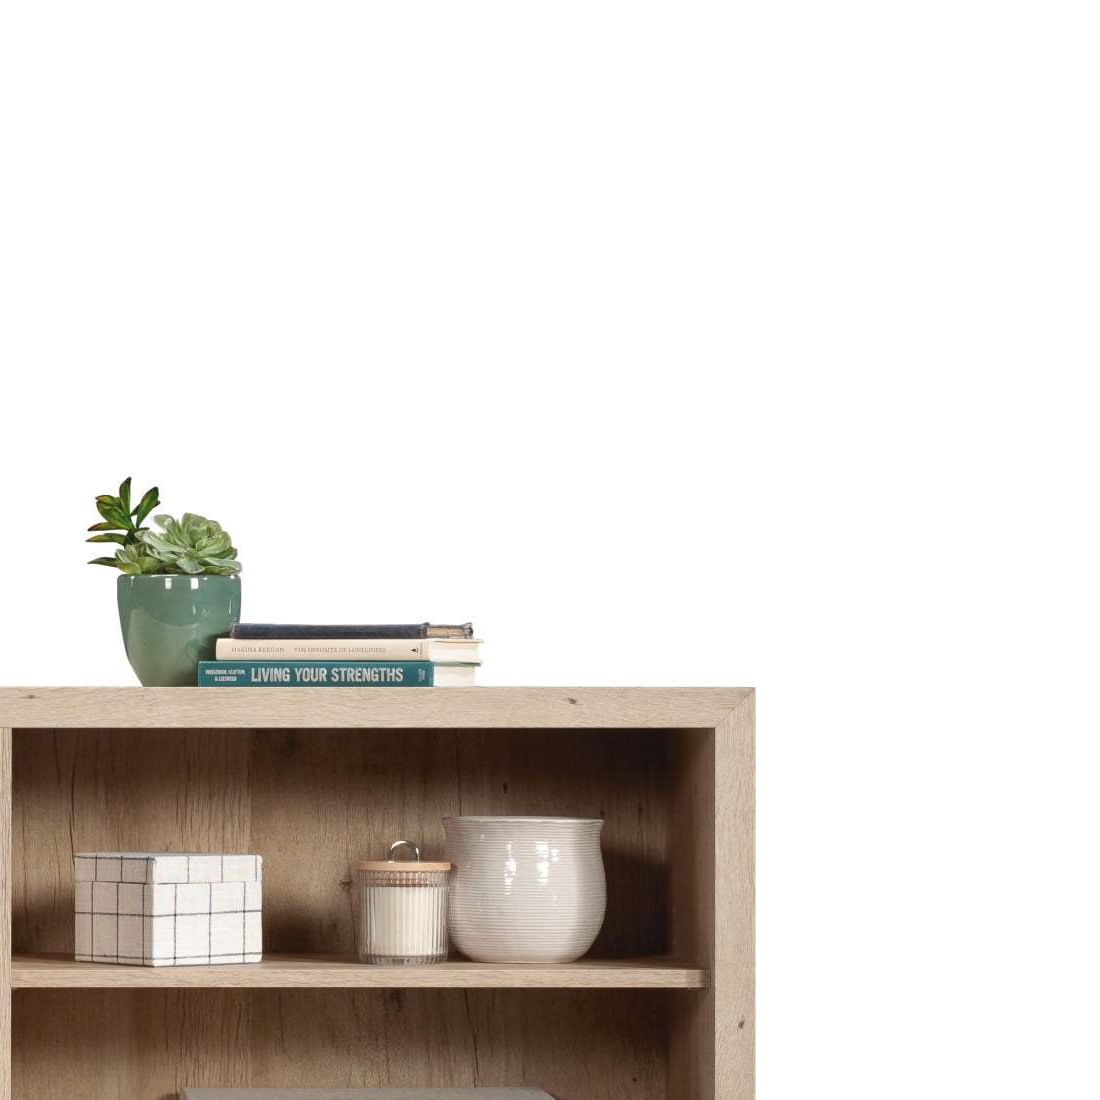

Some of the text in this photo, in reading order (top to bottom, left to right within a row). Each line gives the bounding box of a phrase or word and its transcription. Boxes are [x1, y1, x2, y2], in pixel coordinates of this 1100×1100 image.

[251, 667, 291, 682] LIVING
[294, 667, 328, 682] YOUR
[331, 667, 404, 682] STRENGTHS
